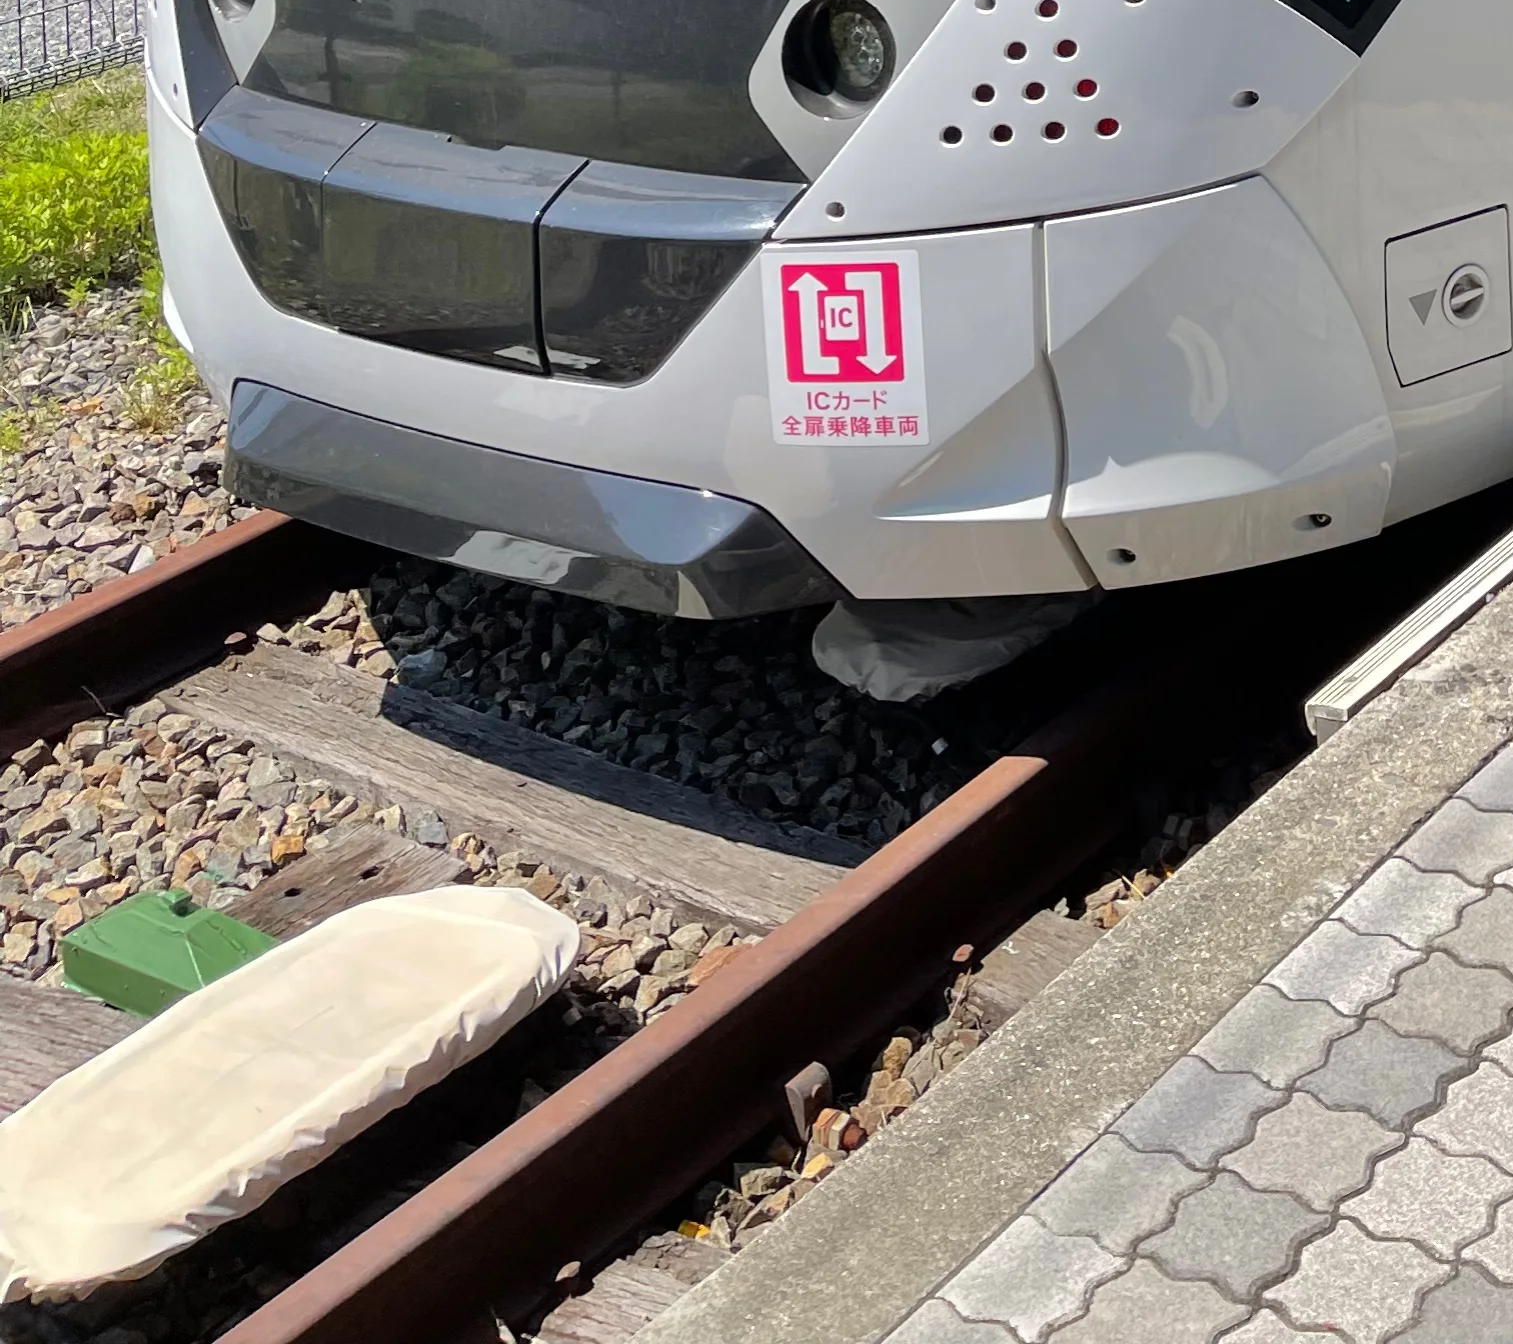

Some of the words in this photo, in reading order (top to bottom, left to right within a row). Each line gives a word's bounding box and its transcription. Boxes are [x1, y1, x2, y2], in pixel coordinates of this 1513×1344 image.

[829, 307, 853, 329] IC
[806, 390, 888, 411] ICカード
[782, 415, 919, 438] 全扉乗降車両
